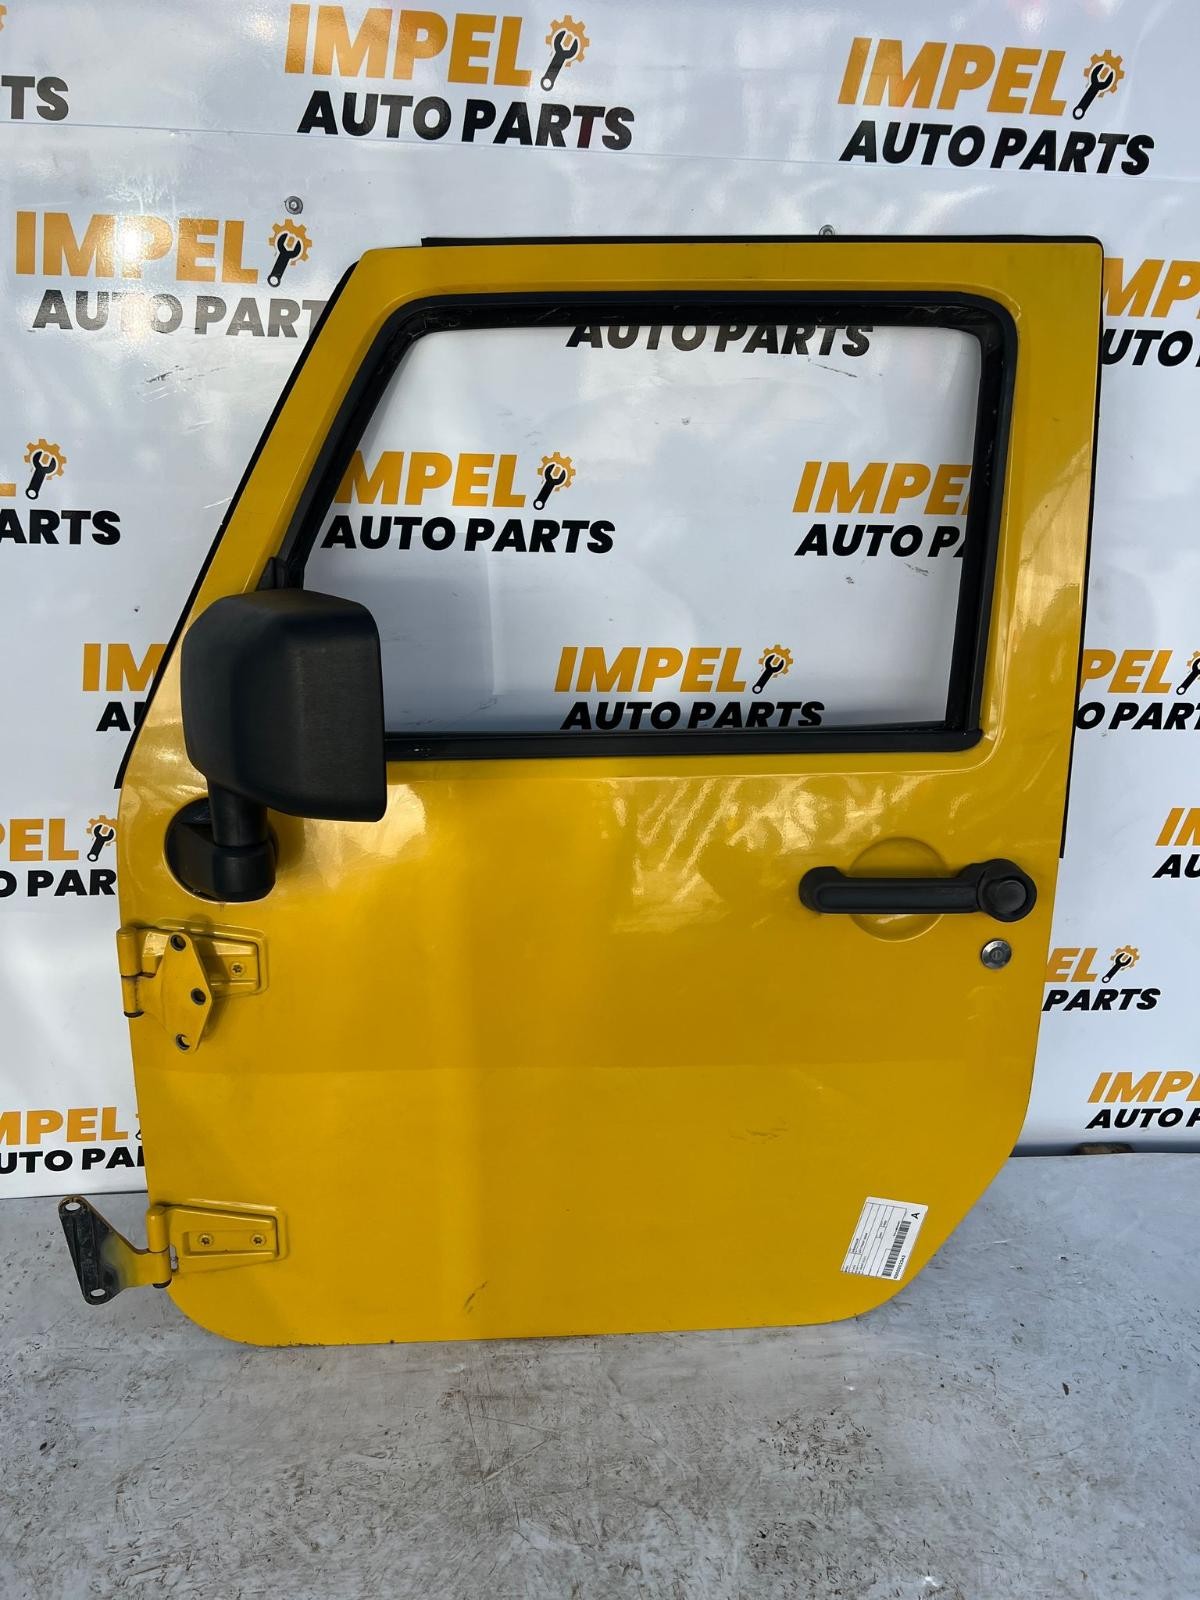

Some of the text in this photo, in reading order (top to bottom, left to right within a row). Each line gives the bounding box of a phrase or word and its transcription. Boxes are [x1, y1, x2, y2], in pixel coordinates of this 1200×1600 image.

[285, 4, 531, 86] IMPEL
[838, 37, 1067, 116] IMPEL
[297, 90, 634, 150] AUTO PARTS
[840, 120, 1154, 175] AUTO PARTS
[16, 211, 258, 284] IMPEL
[1102, 257, 1200, 319] MP
[32, 290, 183, 334] AUTO
[714, 325, 873, 357] PARTS
[793, 462, 971, 515] IMPE
[321, 515, 615, 553] AUTO PARTS
[794, 524, 923, 557] AUTO
[555, 647, 746, 692] IMPEL
[560, 701, 825, 729] AUTO PARTS
[1108, 703, 1200, 729] PAR
[0, 819, 79, 861] EL
[1042, 988, 1160, 1011] PARTS
[1085, 1108, 1183, 1129] AUTO
